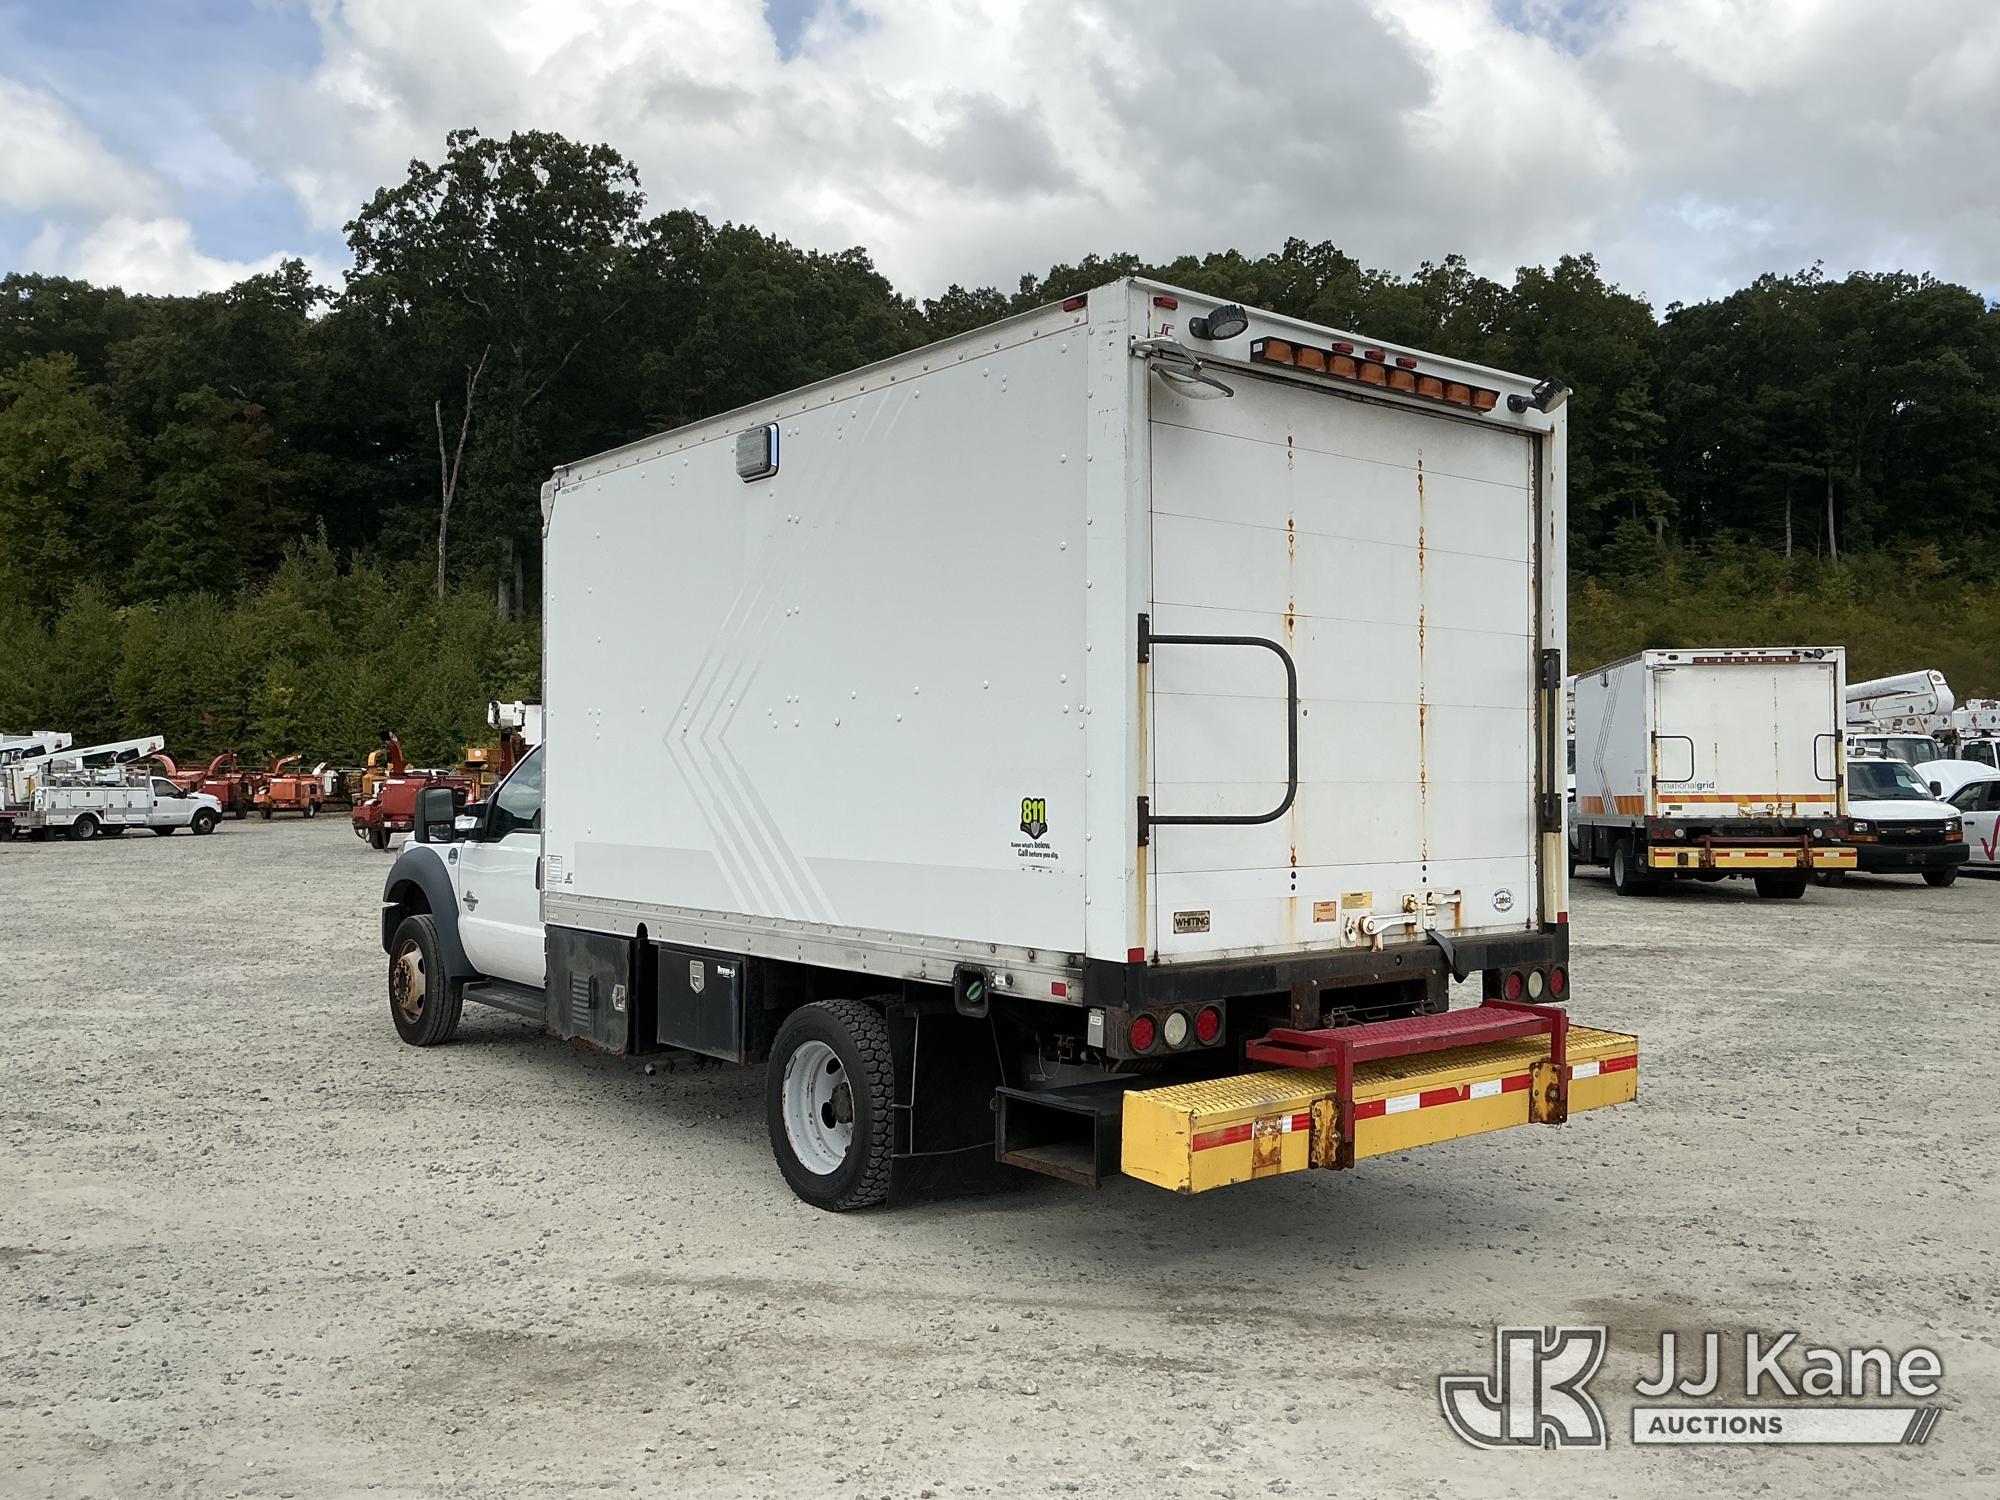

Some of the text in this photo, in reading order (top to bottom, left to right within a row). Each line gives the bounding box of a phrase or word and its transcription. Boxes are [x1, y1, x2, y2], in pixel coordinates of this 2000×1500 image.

[1022, 799, 1045, 824] 811
[1017, 848, 1028, 857] Call
[1175, 916, 1209, 927] WHITING
